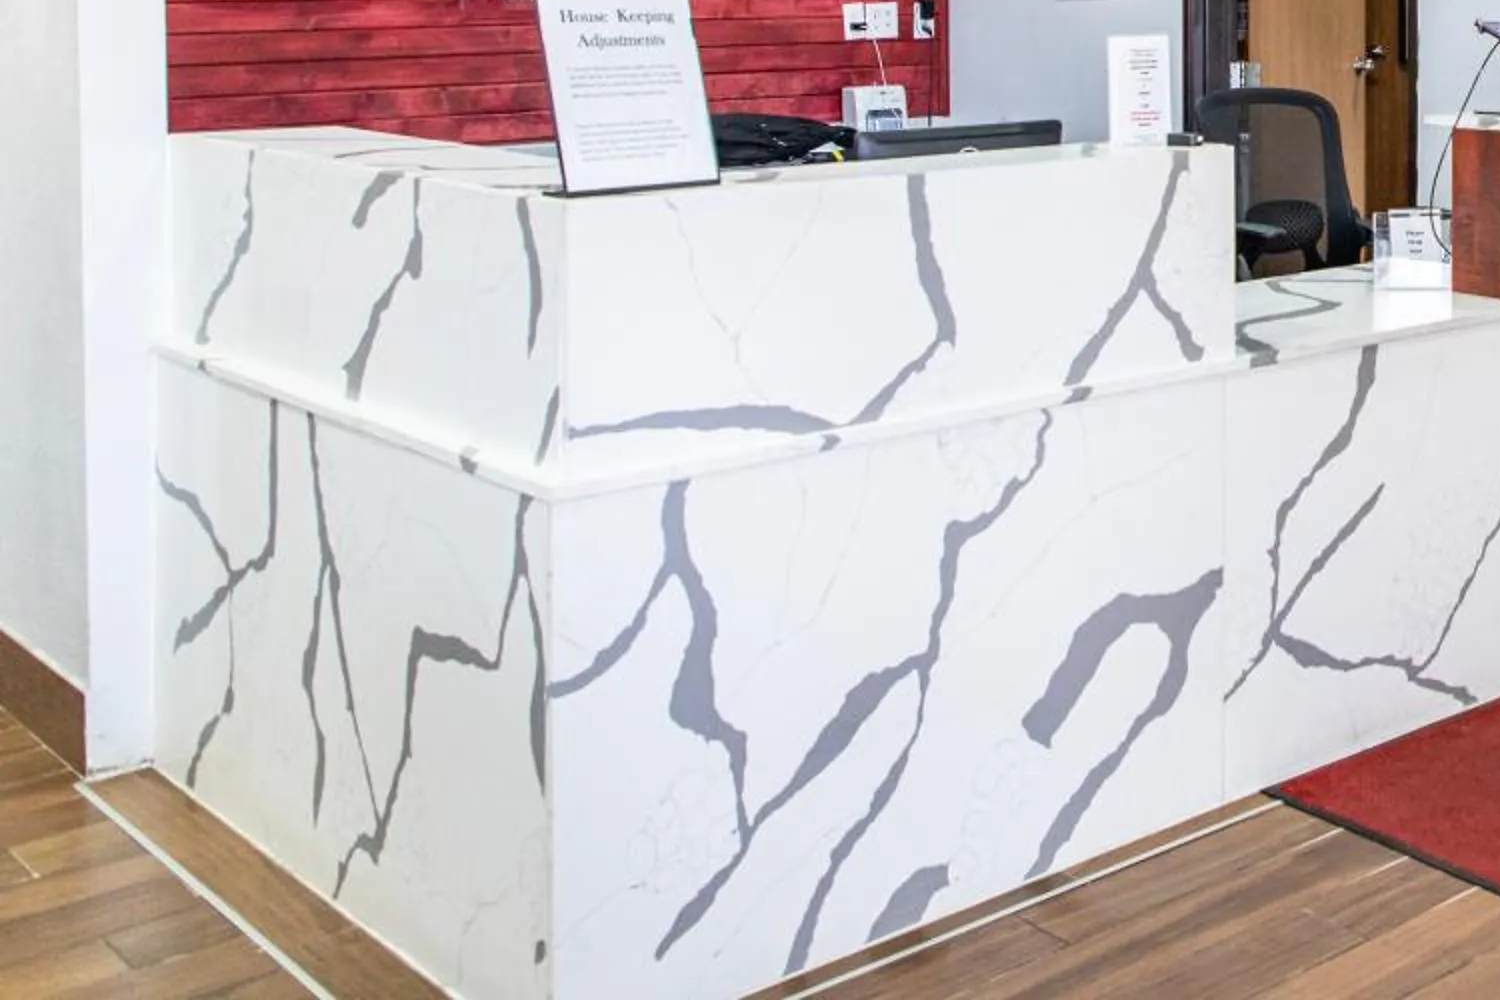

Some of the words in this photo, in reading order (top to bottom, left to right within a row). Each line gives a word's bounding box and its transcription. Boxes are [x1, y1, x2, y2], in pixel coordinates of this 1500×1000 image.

[559, 8, 608, 24] House
[616, 7, 676, 26] Keeping
[577, 33, 666, 51] Adjustments
